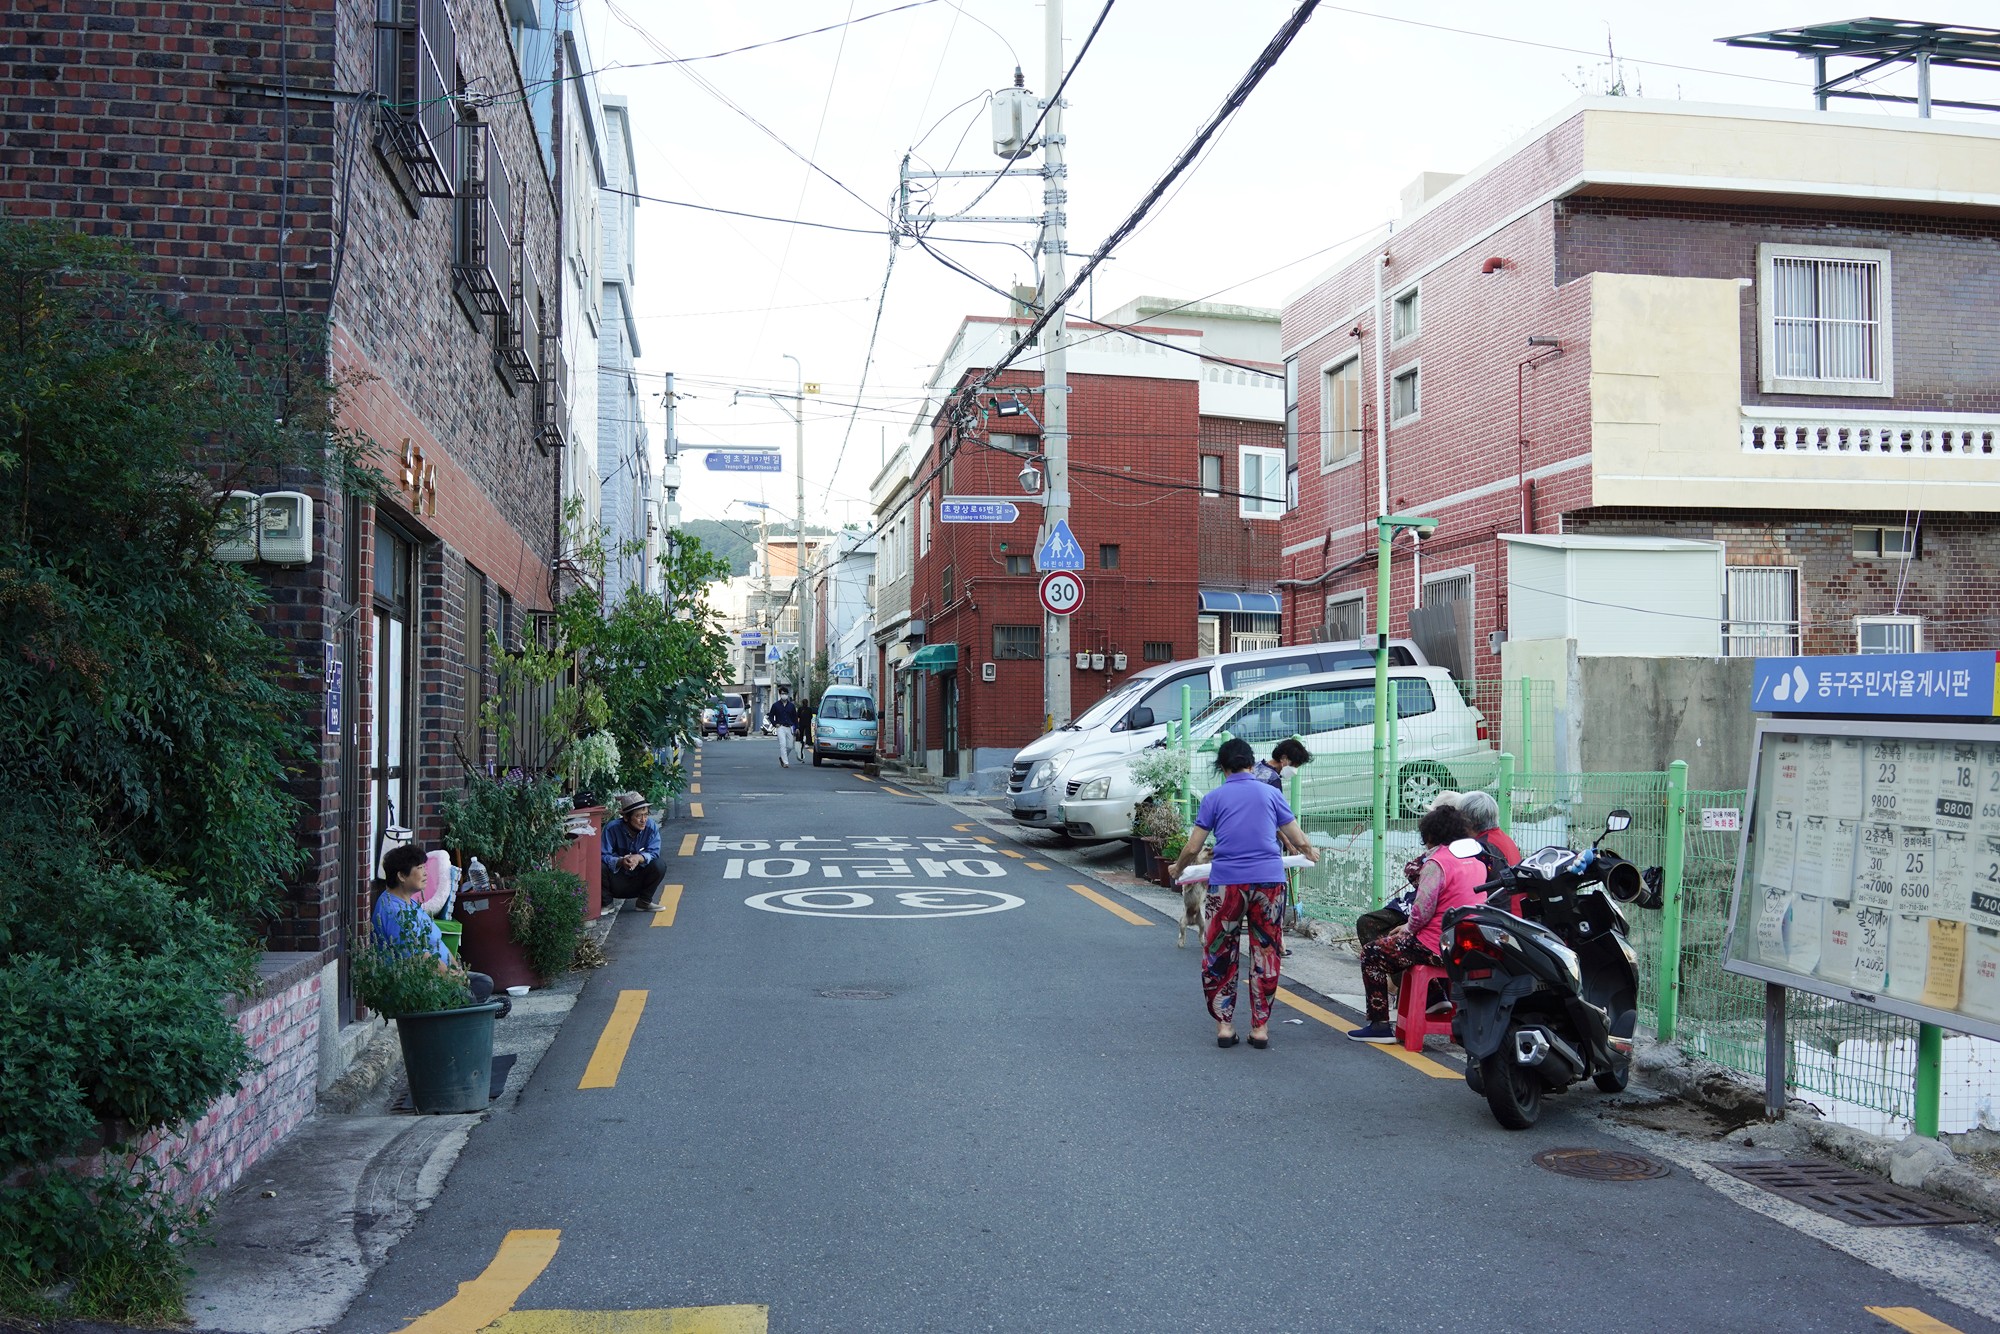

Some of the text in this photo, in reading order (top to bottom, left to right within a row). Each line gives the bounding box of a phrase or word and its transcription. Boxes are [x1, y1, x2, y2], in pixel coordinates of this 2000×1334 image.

[1042, 560, 1080, 568] 어린이보호
[1051, 583, 1074, 602] 30
[1817, 668, 1971, 698] 동구주민자율게시판
[1878, 763, 1896, 784] 23
[1957, 766, 1971, 788] 18
[1871, 794, 1896, 809] 9800
[1943, 802, 1971, 817] 9800
[723, 858, 1007, 879] 어린이
[1870, 857, 1883, 871] 30
[1905, 852, 1924, 874] 25
[1901, 882, 1929, 899] 6500
[1862, 928, 1876, 948] 38
